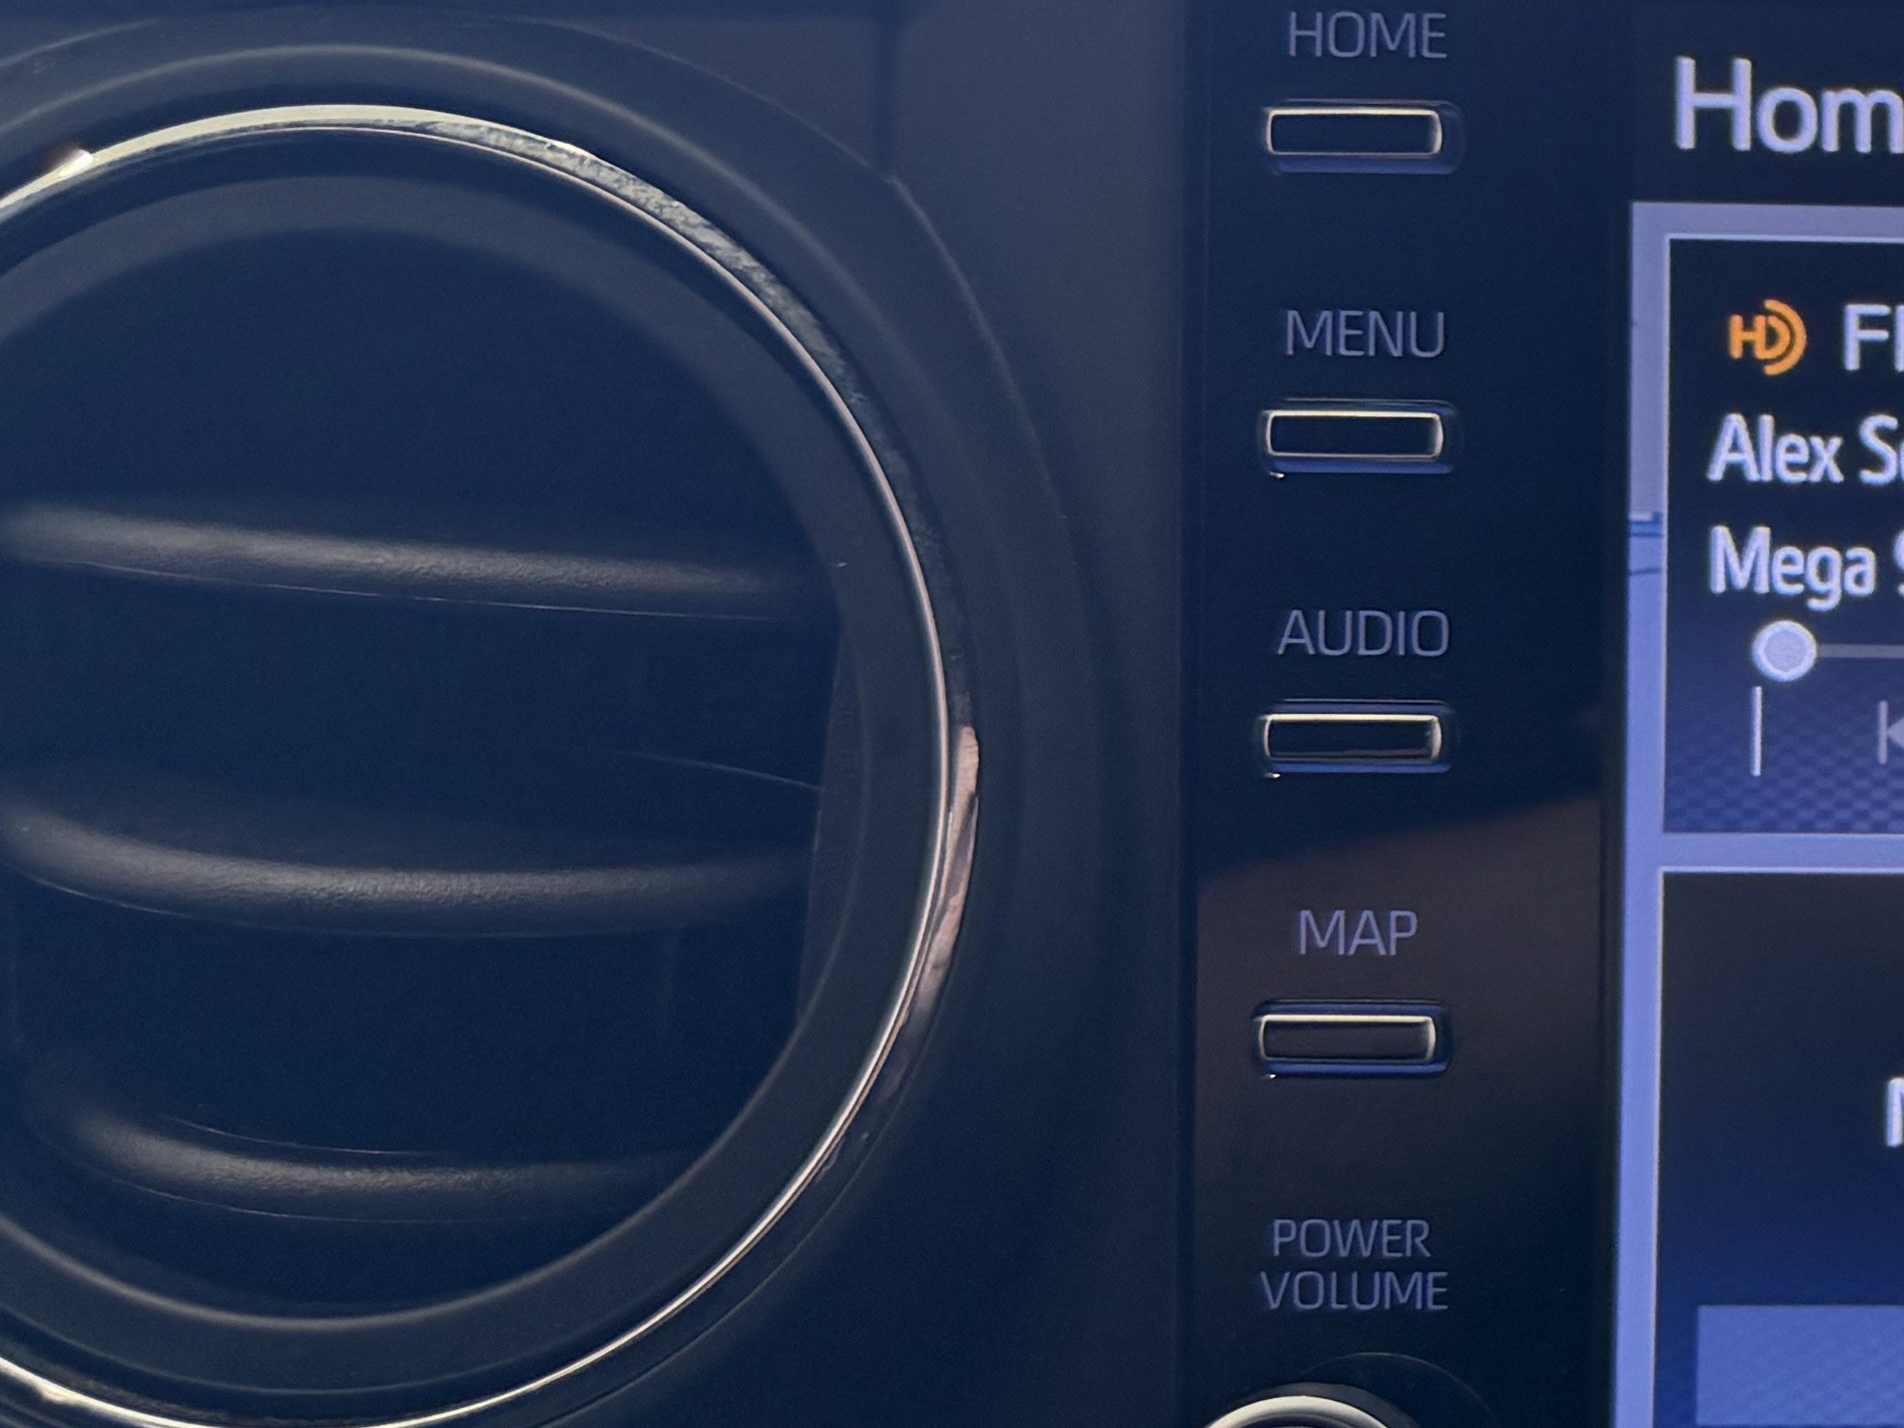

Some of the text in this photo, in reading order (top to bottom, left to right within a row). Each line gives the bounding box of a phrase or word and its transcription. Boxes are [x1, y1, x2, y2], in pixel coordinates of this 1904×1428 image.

[1287, 11, 1447, 59] HOME
[1285, 309, 1445, 359] MENU
[1708, 414, 1843, 483] Alex
[1709, 526, 1875, 611] Mega
[1276, 609, 1450, 657] AUDIO
[1298, 909, 1418, 957] MAP
[1272, 1218, 1431, 1259] POWER
[1261, 1270, 1448, 1312] VOLUME
